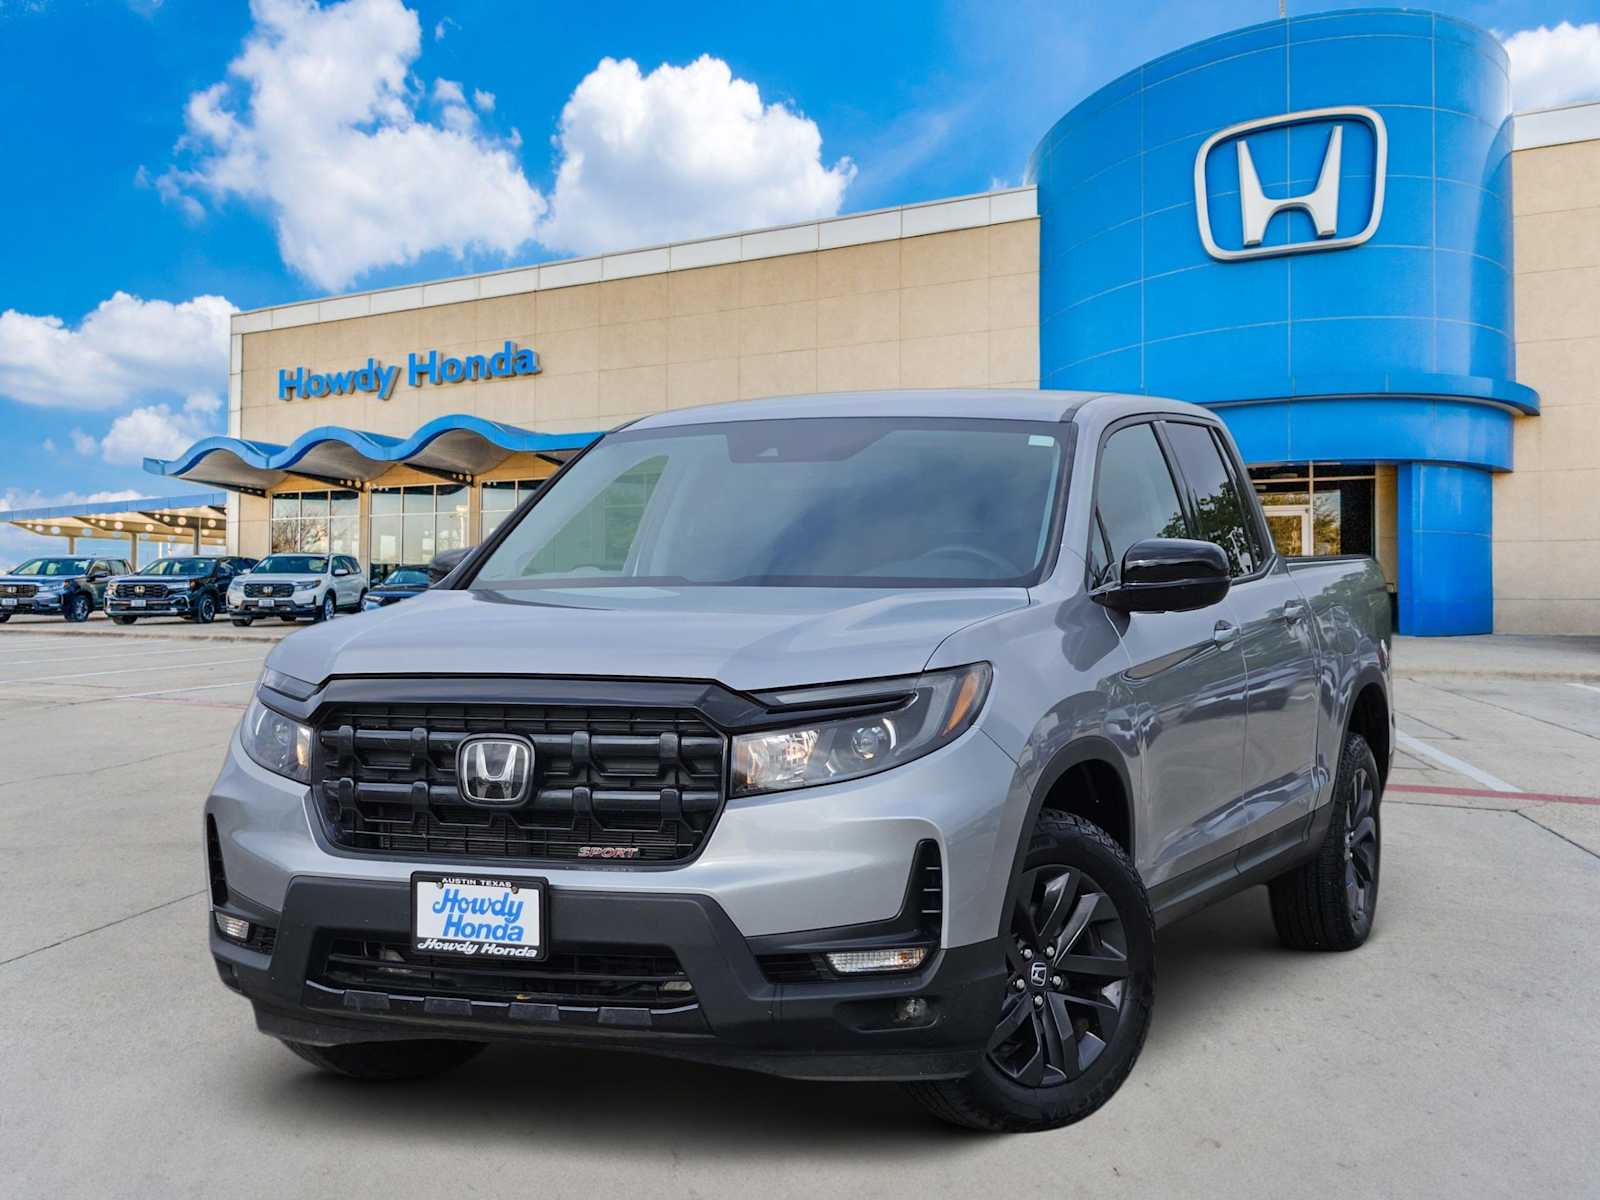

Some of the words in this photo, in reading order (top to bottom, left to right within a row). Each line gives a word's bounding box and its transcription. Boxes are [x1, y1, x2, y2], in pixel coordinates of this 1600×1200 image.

[278, 358, 401, 401] Howdy
[408, 341, 542, 387] Honda
[578, 846, 638, 858] SPORT
[442, 877, 477, 886] AUSTIN
[481, 880, 512, 888] TEXAS
[432, 888, 524, 923] Howdy
[442, 914, 525, 942] Honda
[417, 938, 479, 955] Howdy
[481, 942, 538, 958] Honda
